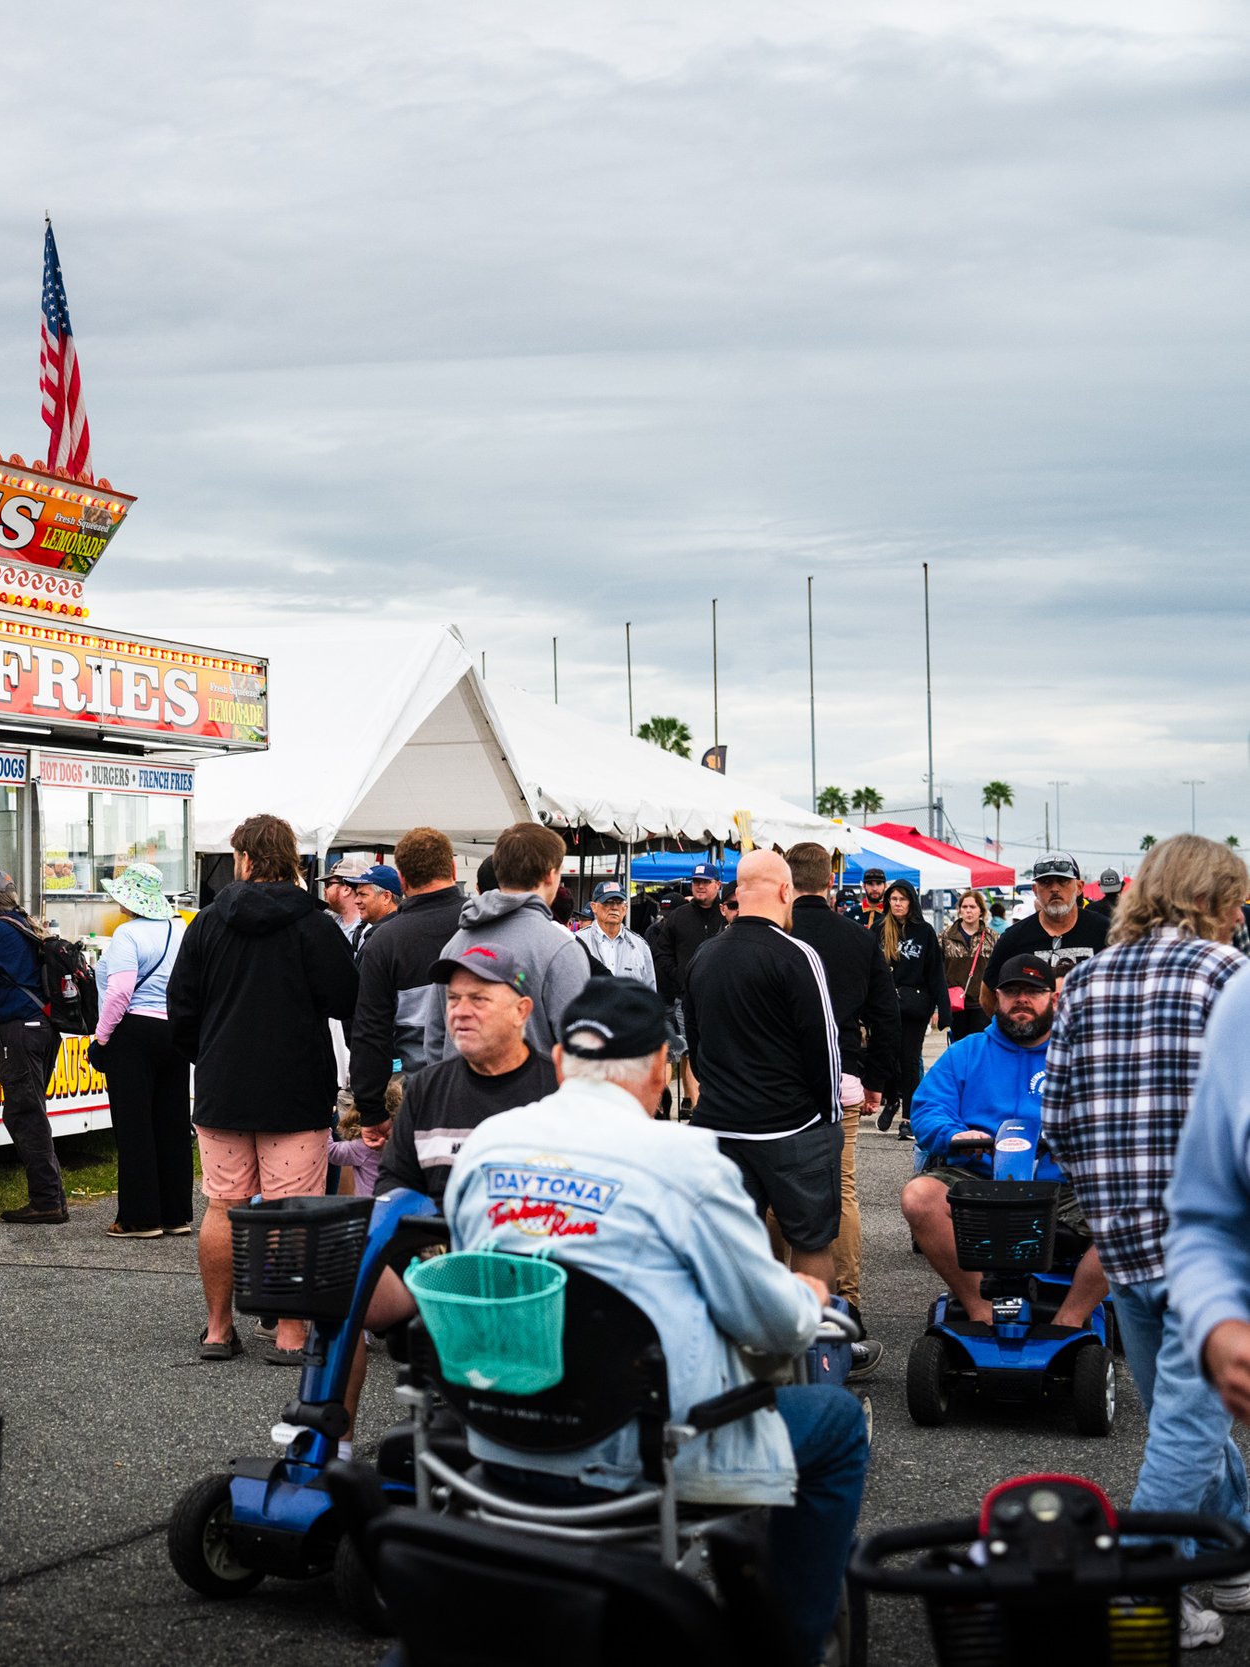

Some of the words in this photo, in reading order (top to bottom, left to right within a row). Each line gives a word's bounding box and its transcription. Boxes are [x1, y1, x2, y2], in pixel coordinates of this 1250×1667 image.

[54, 513, 75, 525] Fresh
[76, 517, 110, 532] Squeezed
[40, 527, 107, 558] LEMONADE
[208, 697, 263, 726] LEMONADE
[40, 761, 58, 781] HOT
[60, 763, 82, 783] DOGS
[92, 766, 130, 786] BURGERS
[139, 769, 169, 790] FRENCH
[170, 772, 193, 792] FRIES
[494, 1173, 600, 1202] DAYTONA
[549, 1210, 597, 1237] Run
